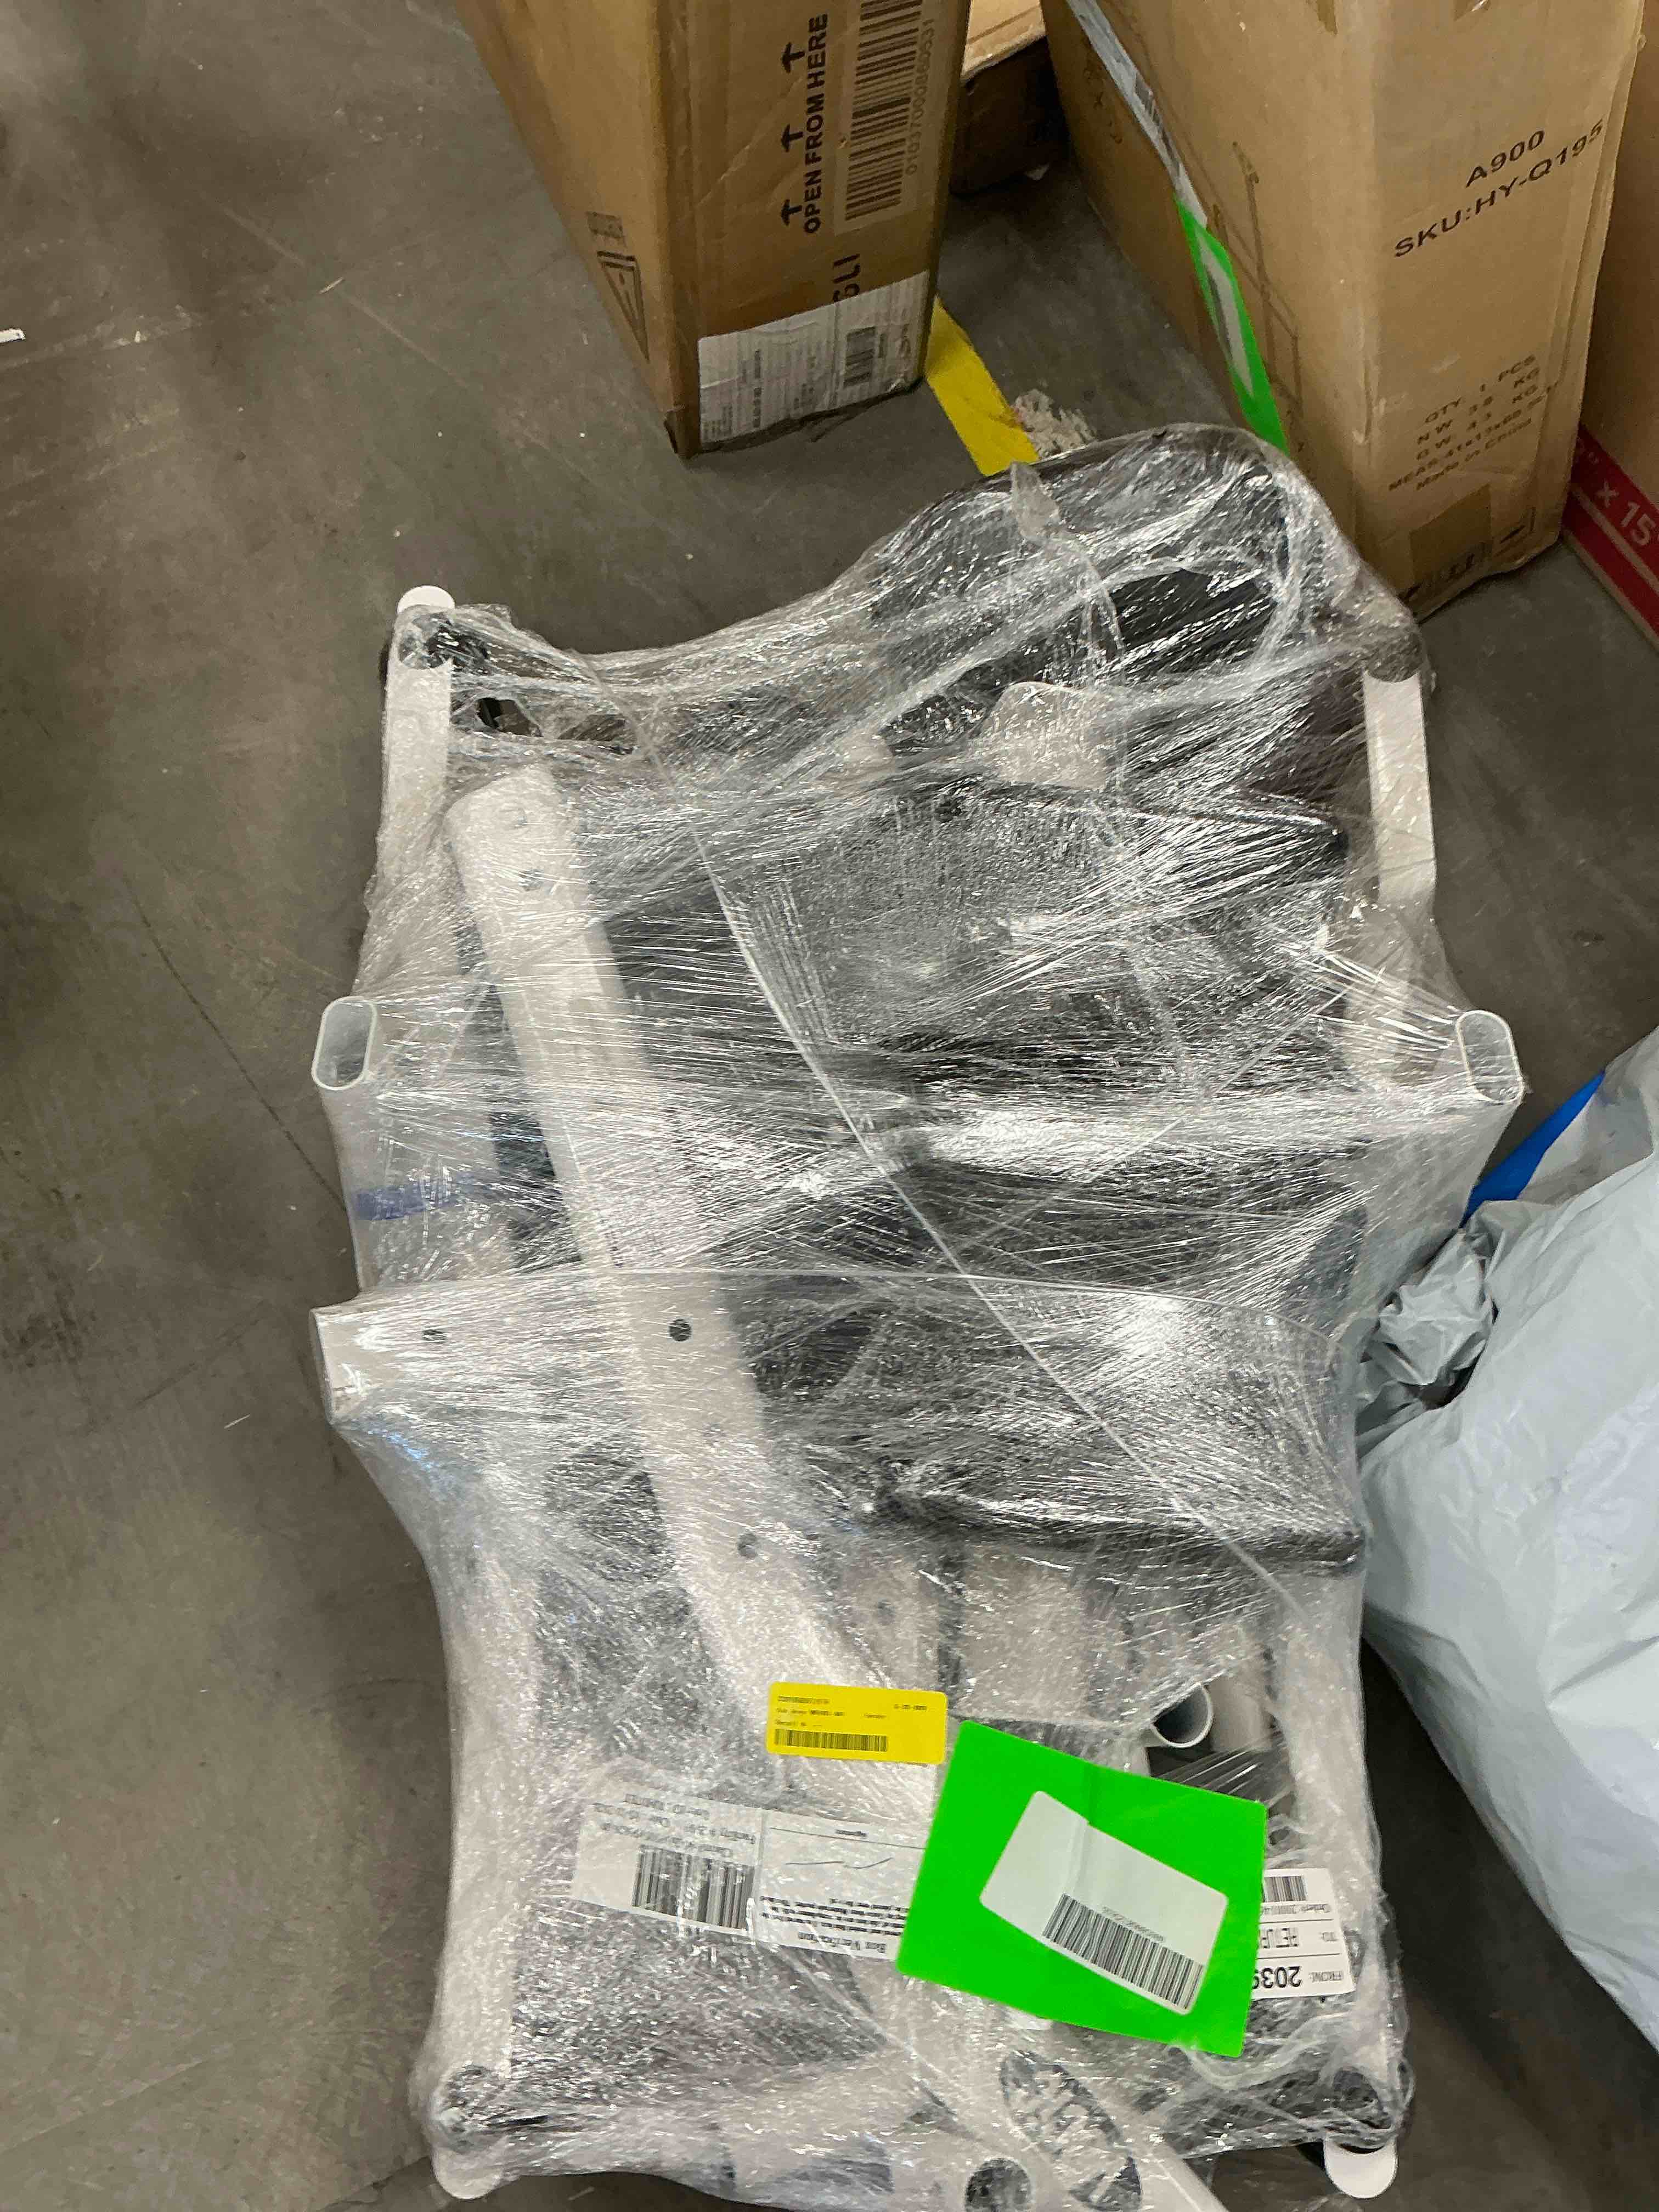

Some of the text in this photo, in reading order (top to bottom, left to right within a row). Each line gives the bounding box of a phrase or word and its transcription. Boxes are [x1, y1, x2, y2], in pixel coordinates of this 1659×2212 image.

[804, 13, 828, 234] OPEN FROM HERE
[1394, 118, 1604, 258] SKU:HY-Q195
[1465, 129, 1545, 188] A900
